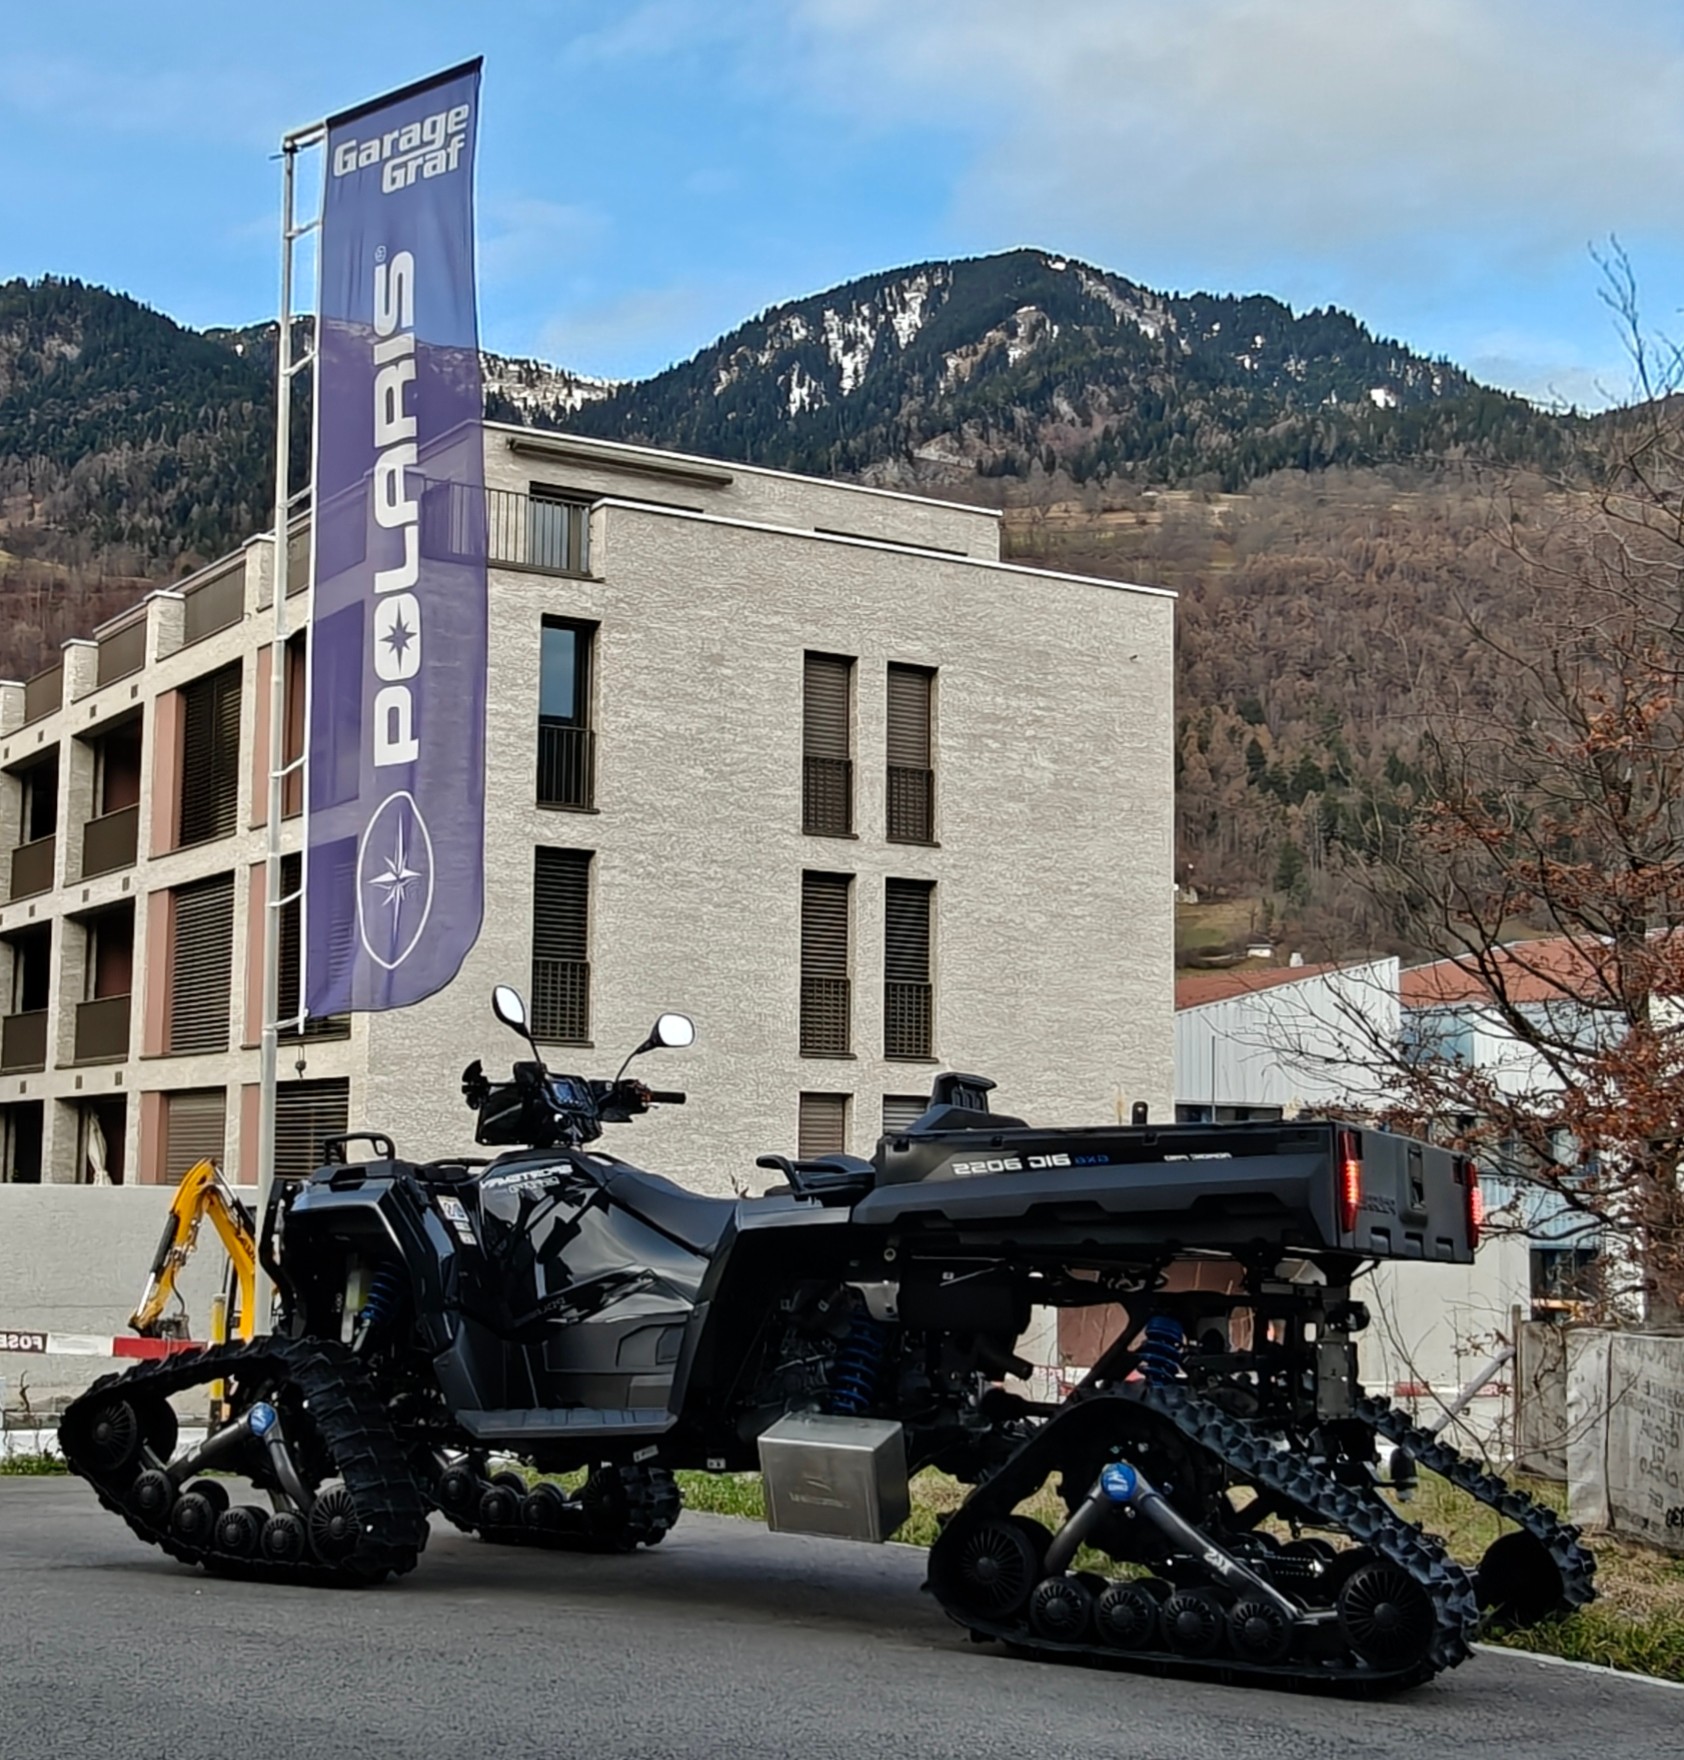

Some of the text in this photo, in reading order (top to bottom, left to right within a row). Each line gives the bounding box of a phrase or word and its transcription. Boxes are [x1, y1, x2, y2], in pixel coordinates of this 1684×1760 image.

[333, 104, 470, 177] Garage
[382, 133, 465, 195] Graf
[373, 250, 422, 768] POLARIS
